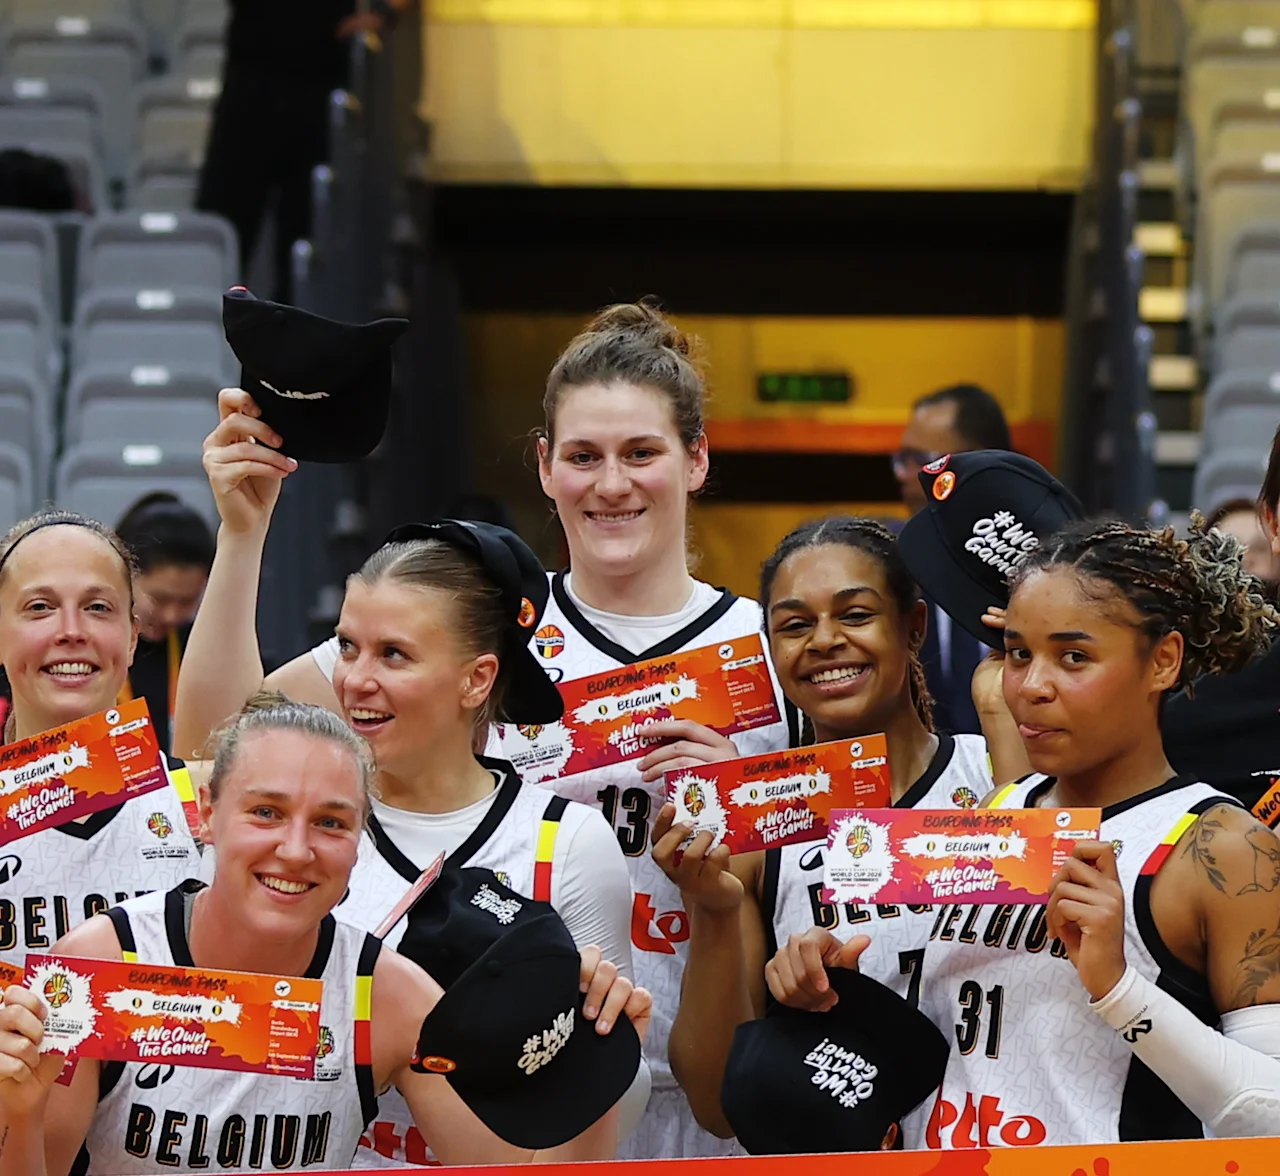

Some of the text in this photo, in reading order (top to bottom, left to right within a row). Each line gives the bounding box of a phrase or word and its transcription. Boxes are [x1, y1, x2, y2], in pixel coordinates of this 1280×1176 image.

[993, 509, 1040, 553] #We
[963, 535, 1020, 578] Game
[586, 661, 677, 694] BOARDING PASS
[616, 691, 663, 712] BELGIUM
[13, 761, 56, 785] BELGIUM
[765, 782, 802, 798] BELGIUM
[944, 841, 990, 853] BELGIUM
[151, 999, 202, 1014] BELGIUM
[955, 979, 1006, 1060] 31
[814, 1037, 880, 1082] Game!
[811, 1069, 860, 1110] #We
[124, 1101, 333, 1171] BELGIUM
